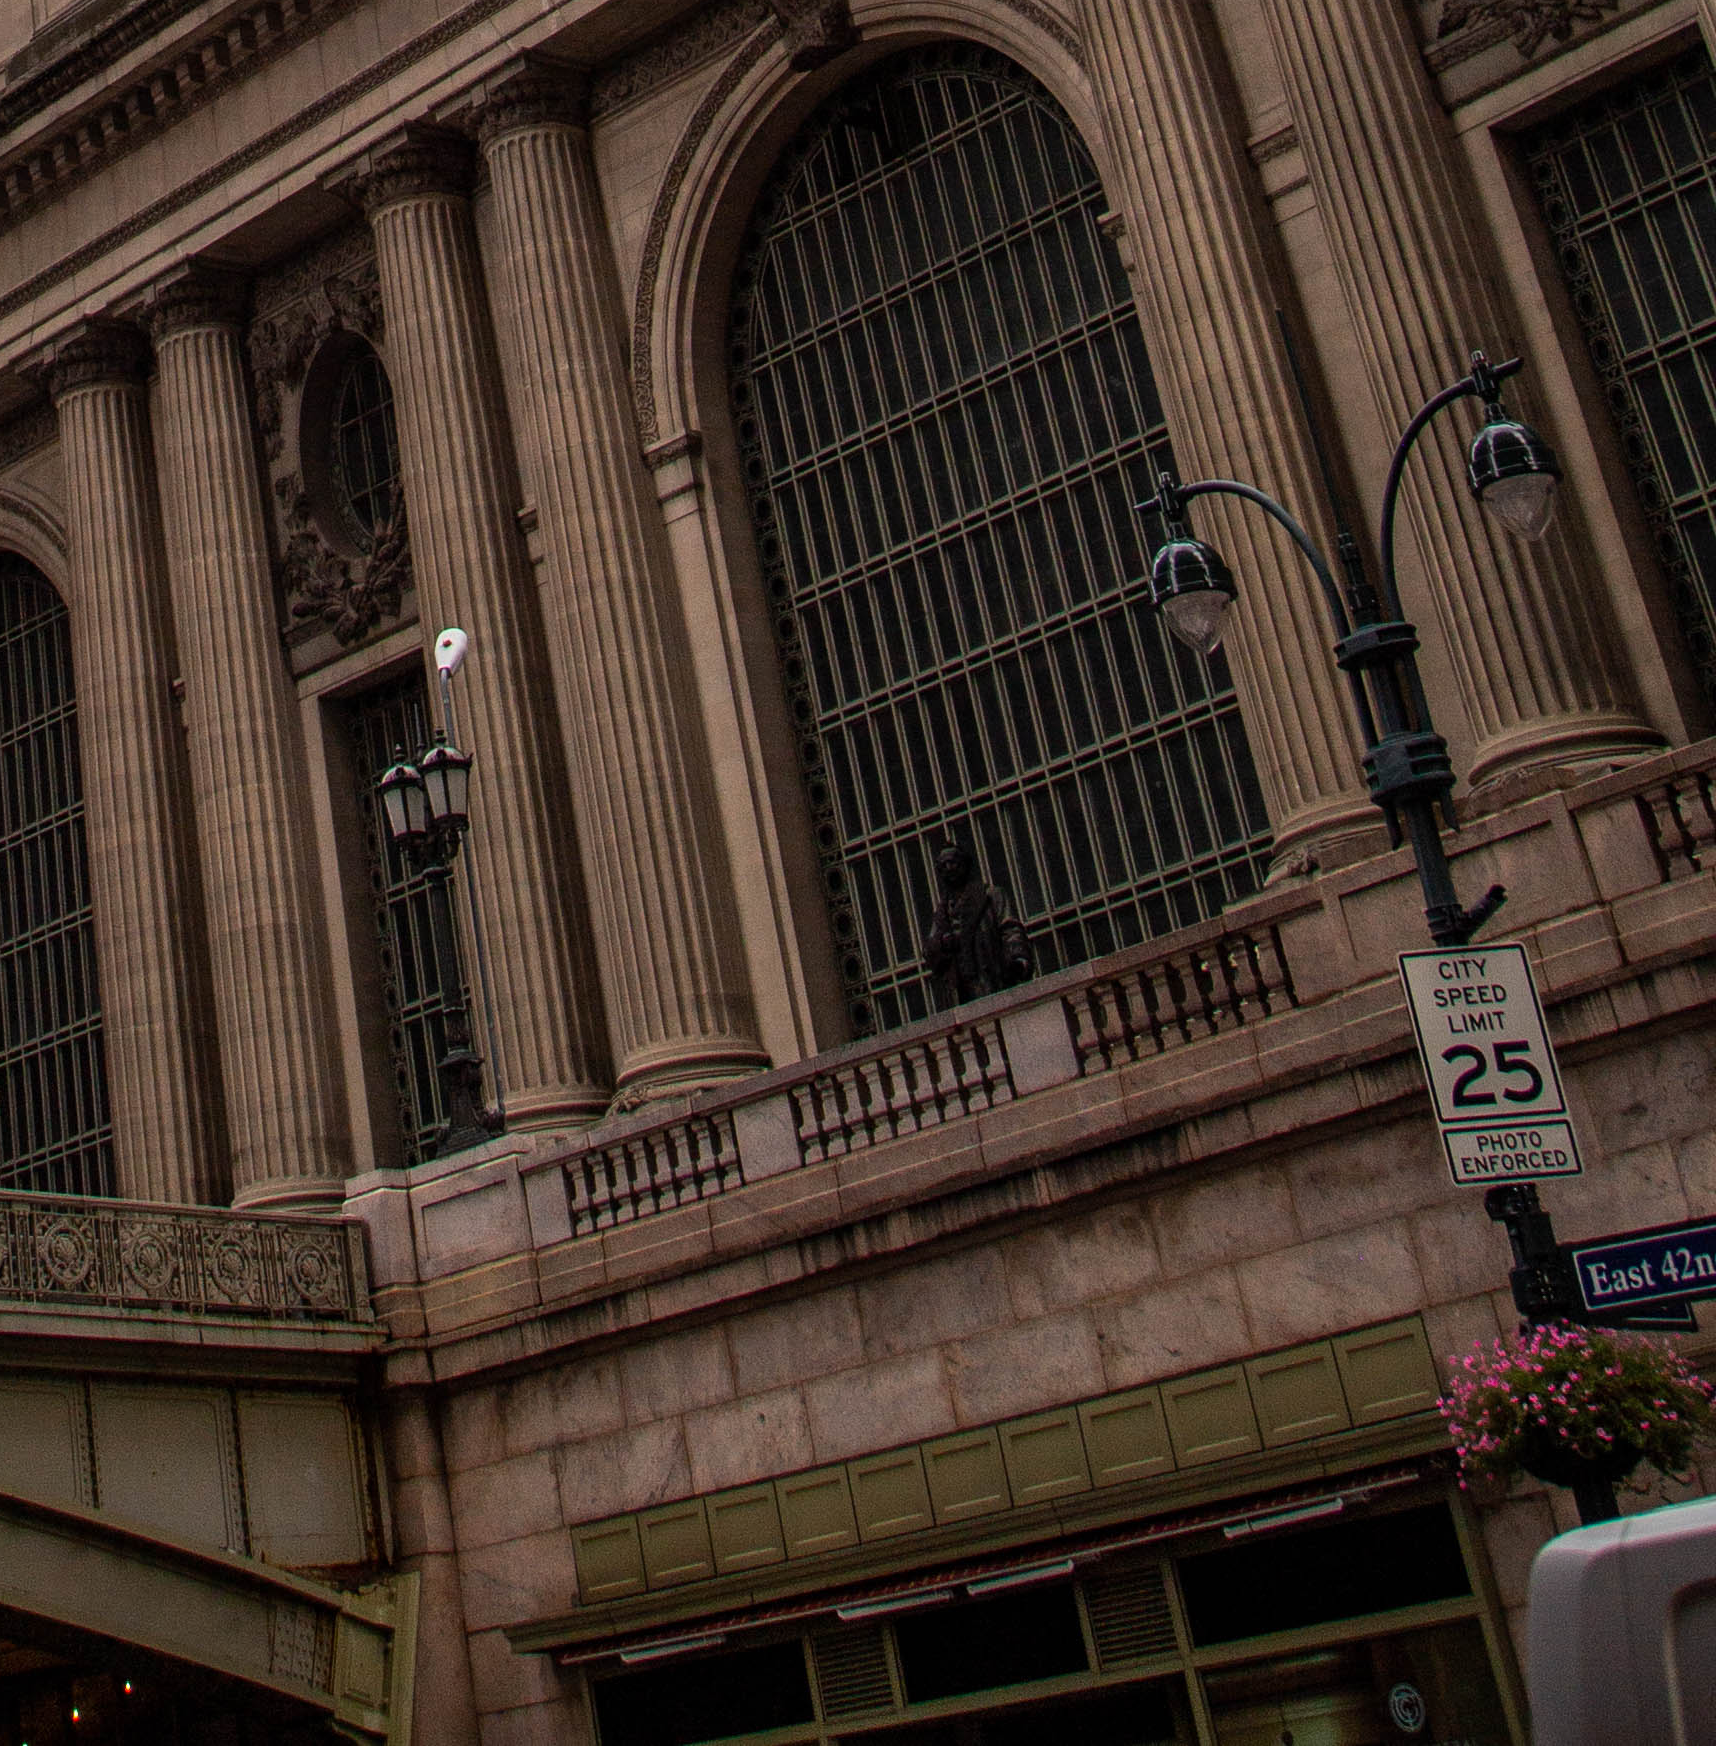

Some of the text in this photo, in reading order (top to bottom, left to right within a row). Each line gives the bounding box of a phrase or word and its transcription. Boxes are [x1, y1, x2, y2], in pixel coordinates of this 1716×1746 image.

[1438, 958, 1487, 980] CITY
[1433, 984, 1507, 1008] SPEED
[1447, 1010, 1506, 1034] LIMIT
[1440, 1039, 1544, 1108] 25
[1476, 1131, 1542, 1152] PHOTO
[1461, 1149, 1568, 1174] ENFORCED
[1586, 1246, 1716, 1296] East 42n
